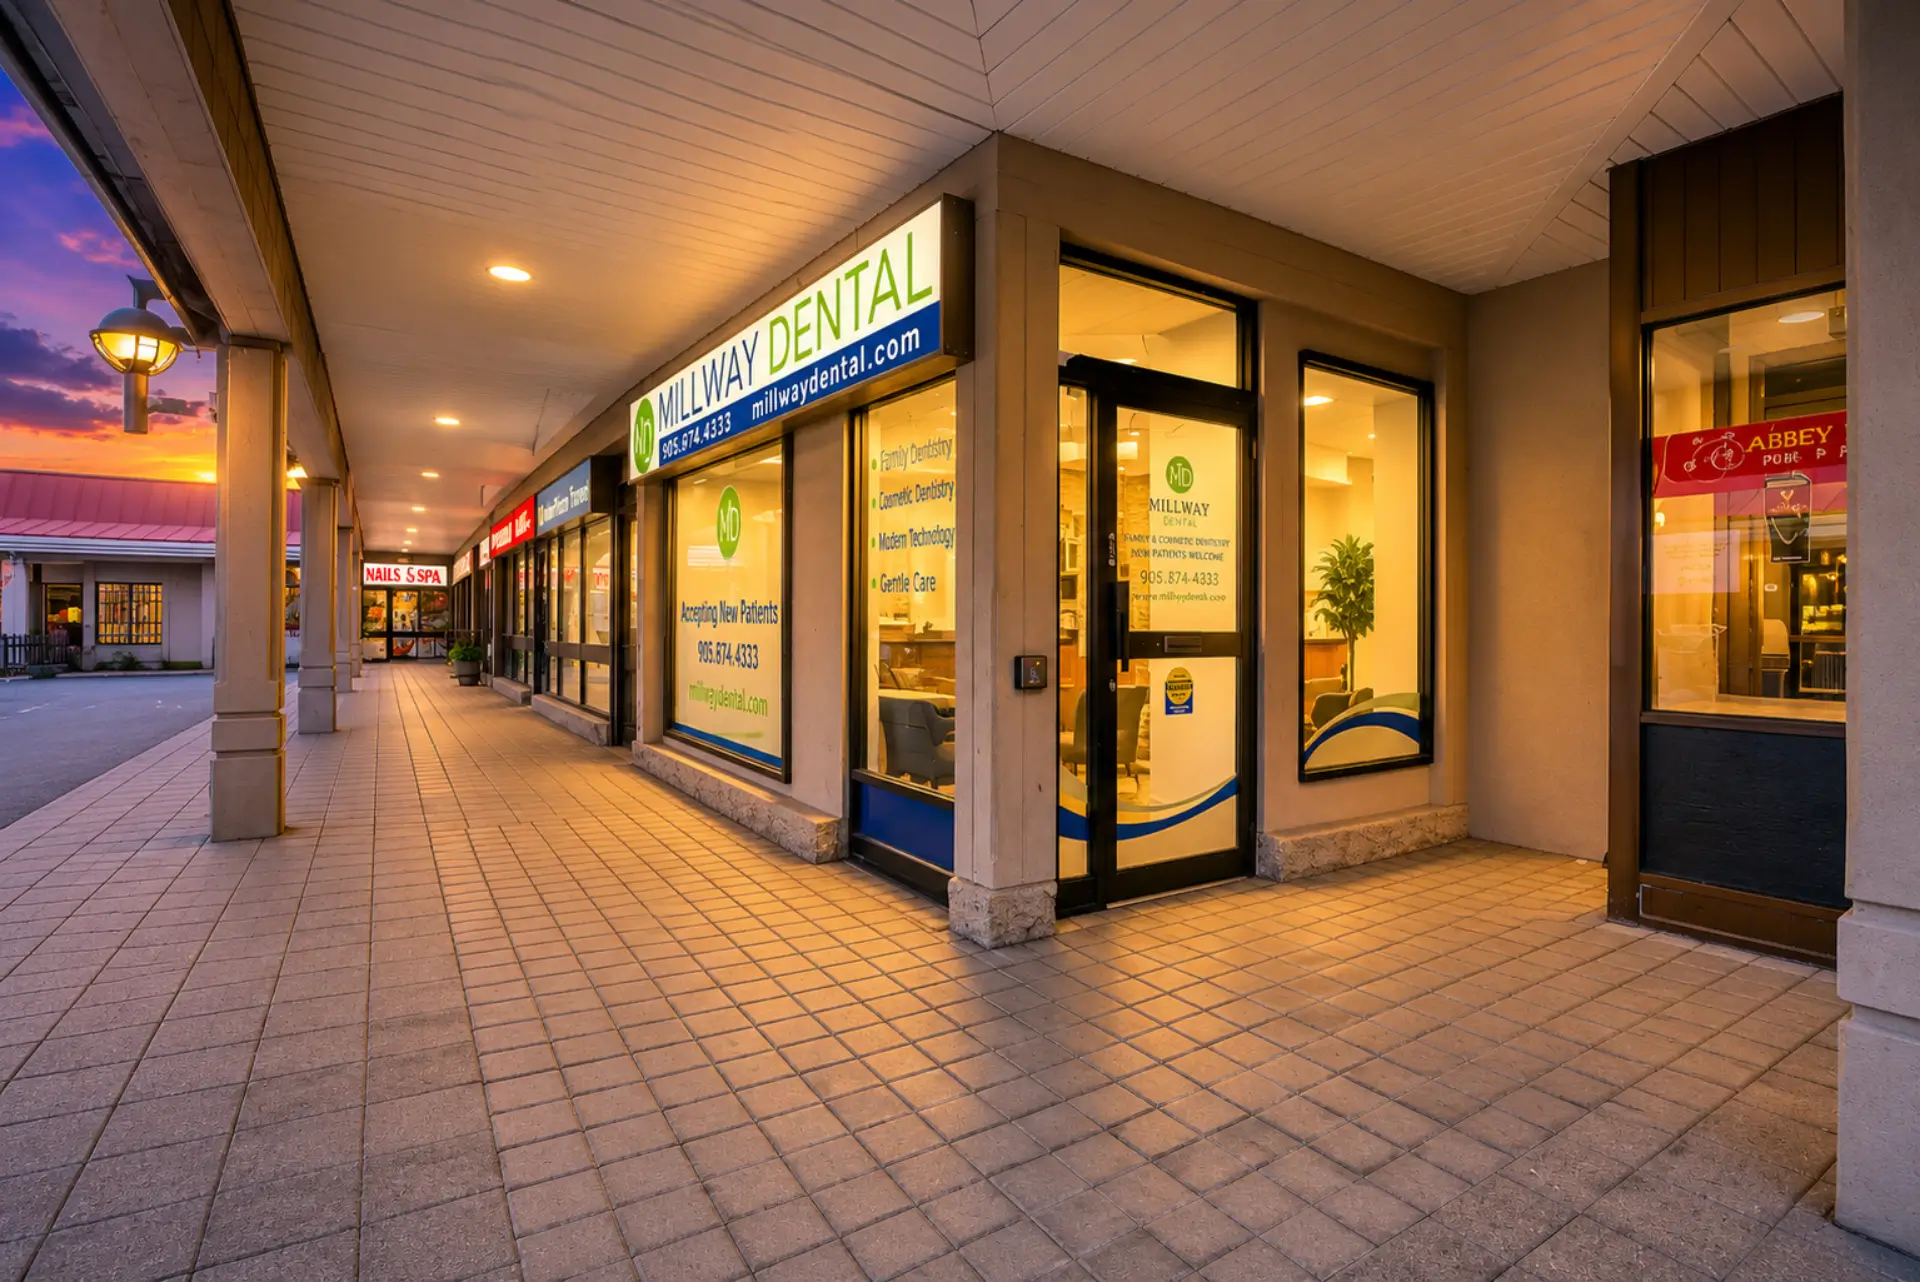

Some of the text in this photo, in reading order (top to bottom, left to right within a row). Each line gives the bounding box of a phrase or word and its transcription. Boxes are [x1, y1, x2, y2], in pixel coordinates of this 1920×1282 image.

[658, 232, 933, 432] MILLWAY DENTAL
[752, 328, 920, 420] millwaydental.com
[1746, 425, 1833, 453] ABBEY
[880, 437, 953, 472] Family Dentistry
[880, 479, 954, 511] Cosmetic Dentistry
[1149, 498, 1210, 517] MILLWAY
[1163, 516, 1197, 528] DENTAL
[879, 525, 955, 551] Modern Technology
[366, 567, 401, 582] NAILS
[417, 569, 442, 584] SPA
[880, 572, 936, 593] Gentle Care
[681, 600, 779, 628] Accepting New Patients
[698, 641, 759, 670] 905.874.4333
